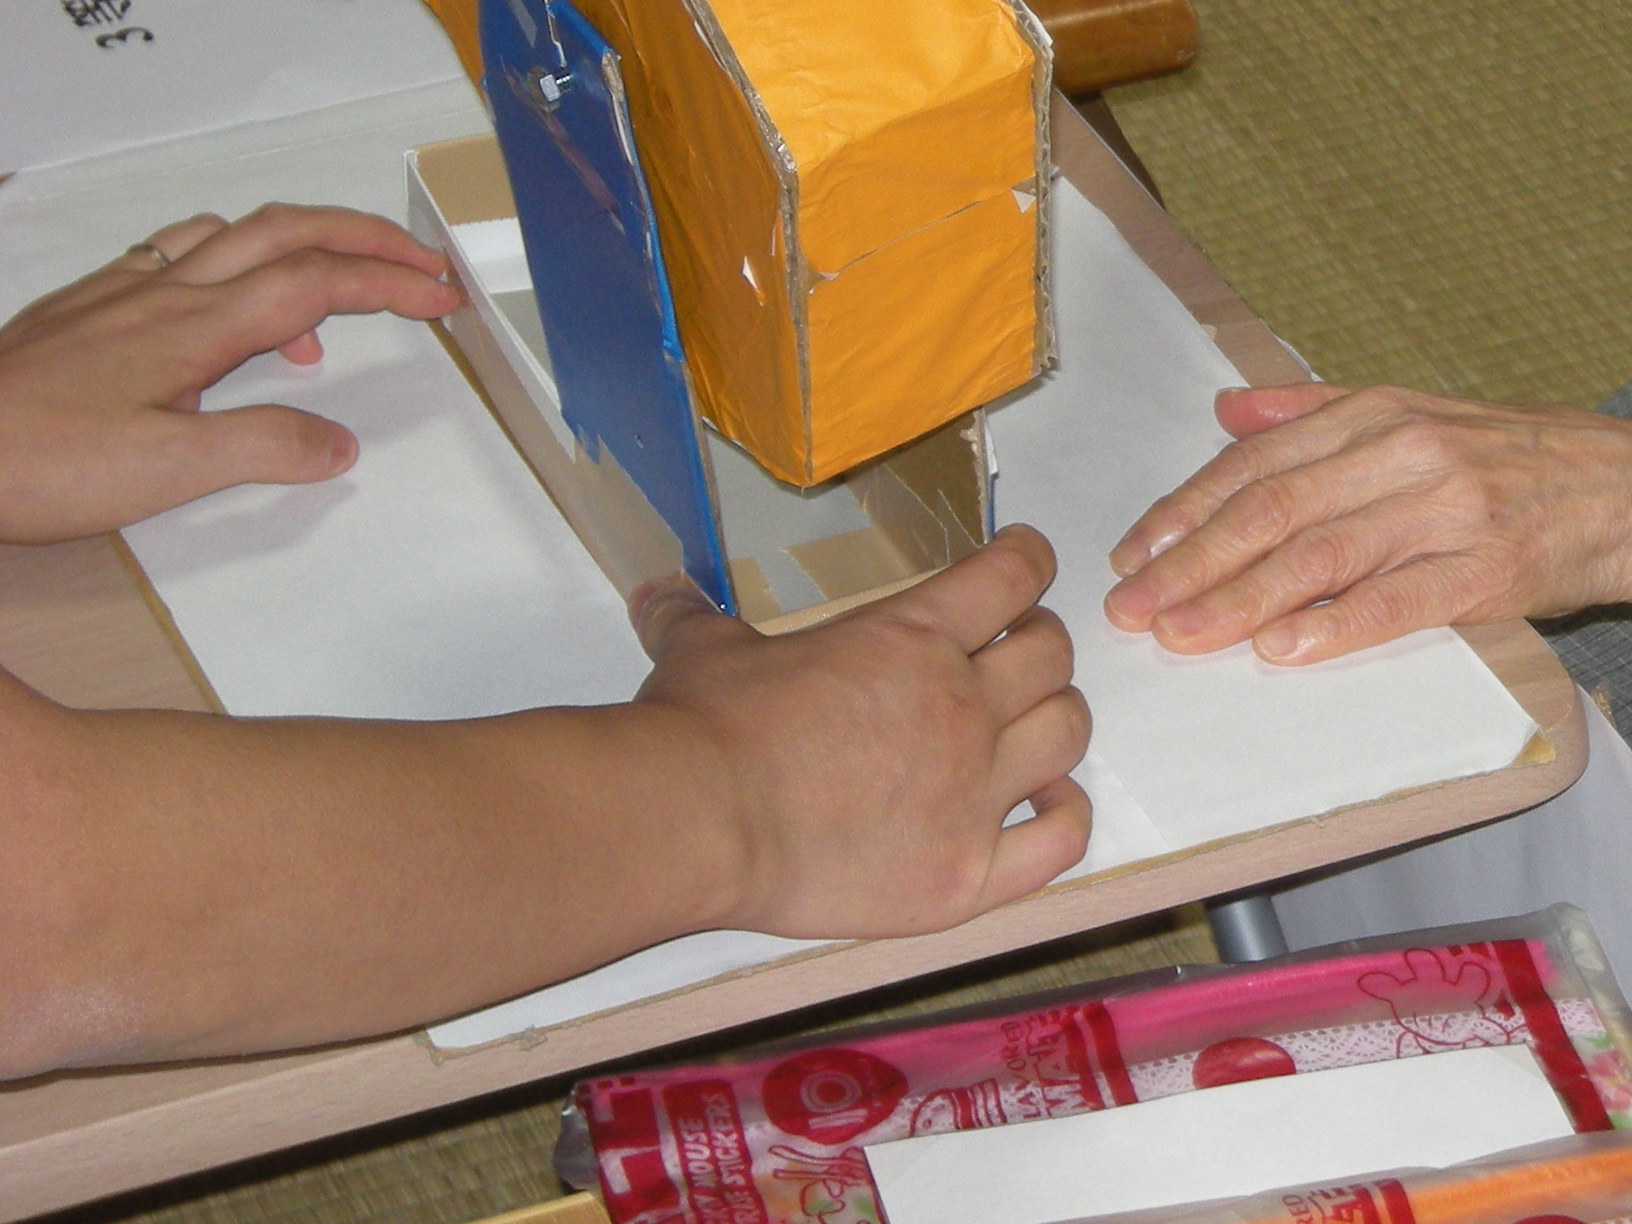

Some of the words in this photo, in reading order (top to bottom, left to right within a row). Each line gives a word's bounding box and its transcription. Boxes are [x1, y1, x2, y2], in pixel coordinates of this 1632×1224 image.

[1000, 1020, 1042, 1119] LAVORED
[678, 1117, 718, 1189] MOUSE
[704, 1093, 746, 1187] STICKERS
